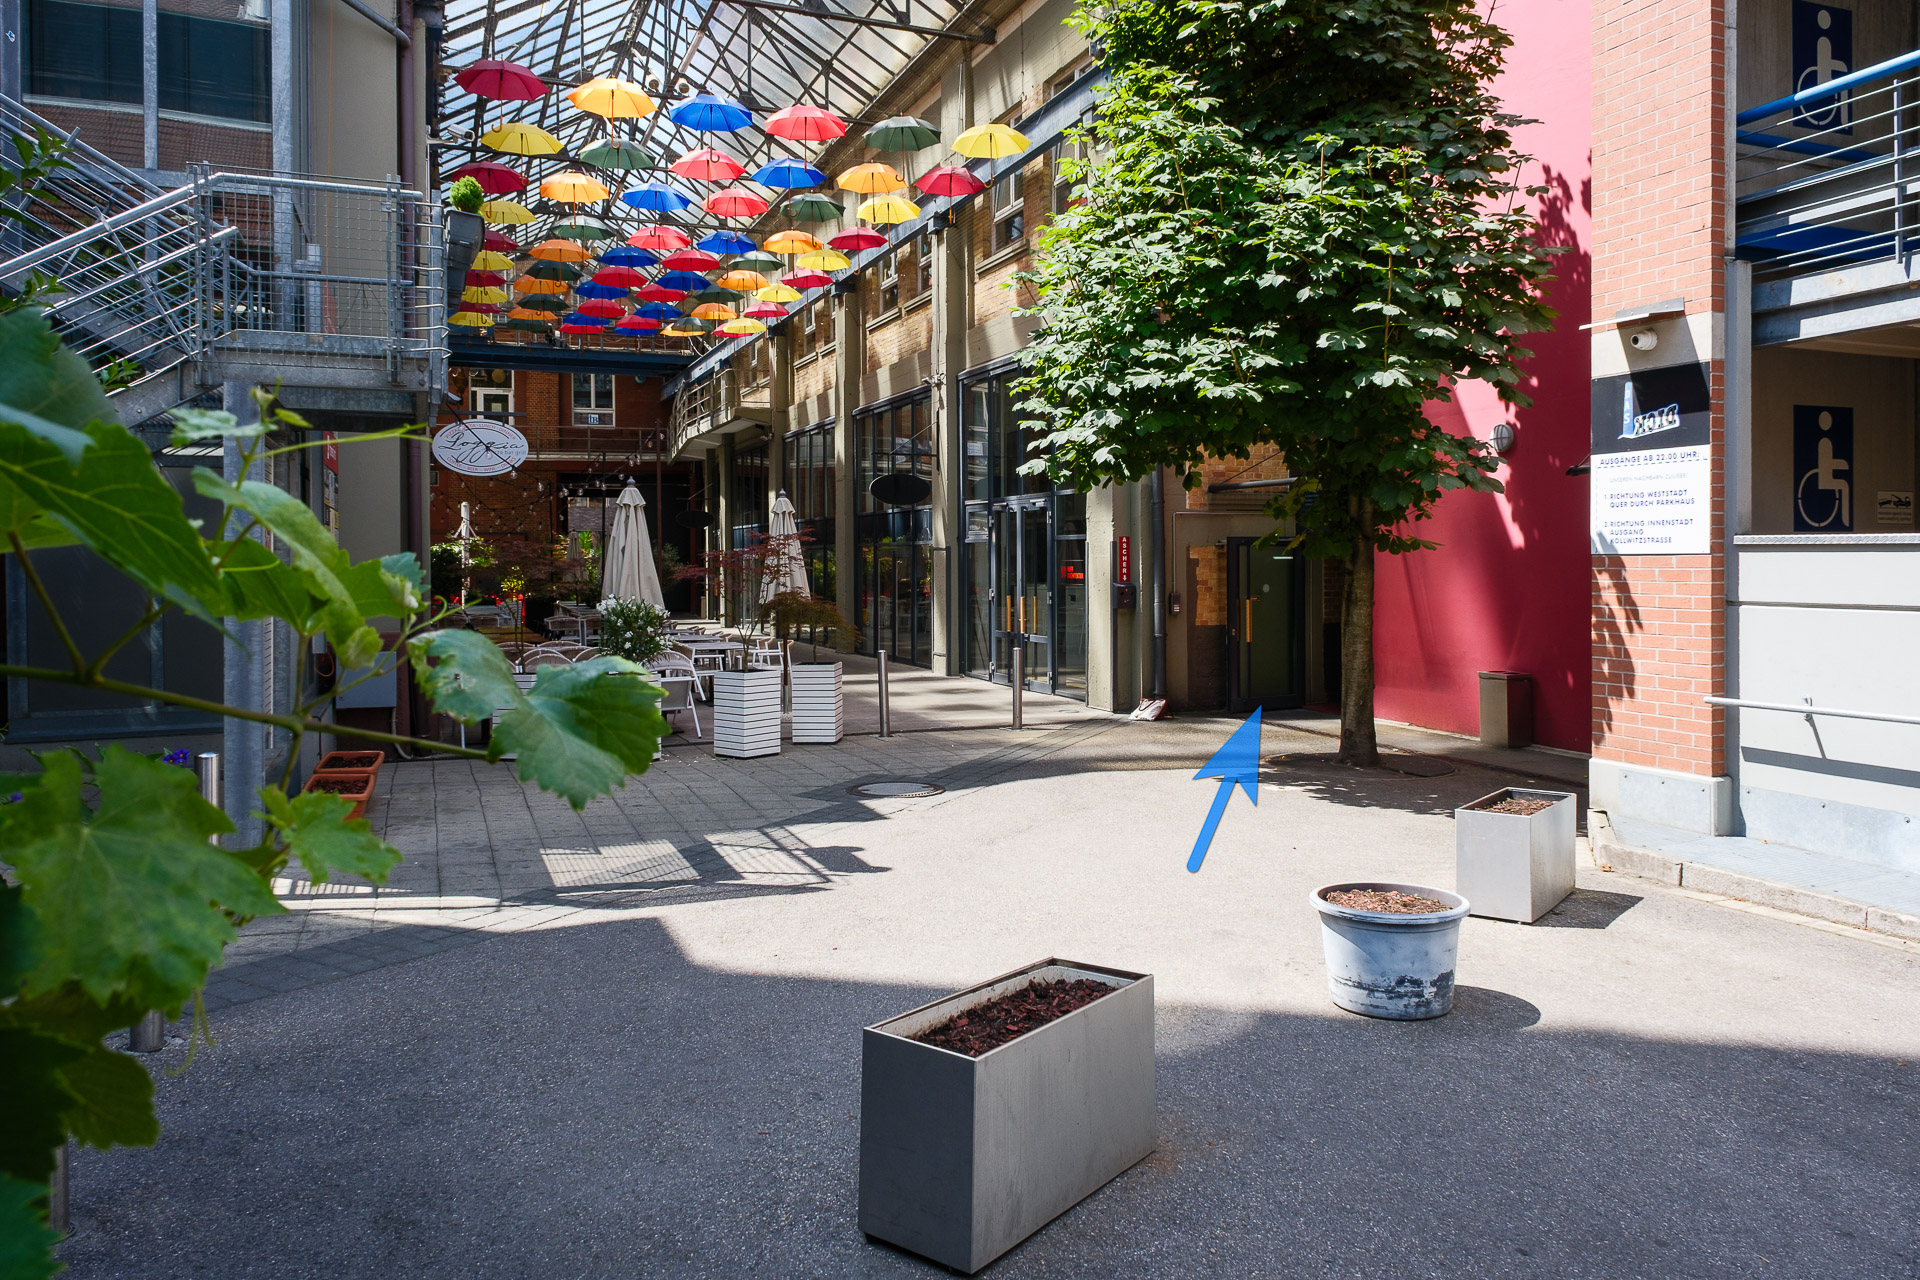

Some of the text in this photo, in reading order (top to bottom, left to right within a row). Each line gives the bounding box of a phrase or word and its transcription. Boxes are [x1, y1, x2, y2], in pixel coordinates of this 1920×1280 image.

[1623, 389, 1631, 425] DAS
[438, 431, 525, 464] Loggia
[1643, 454, 1654, 462] AB
[1656, 452, 1678, 461] 22.00
[1610, 491, 1645, 500] RICHTUNG
[1647, 489, 1687, 498] WESTSTADT
[1630, 500, 1654, 508] DURCH
[1656, 497, 1695, 506] PARKHAUS
[1610, 520, 1645, 528] RICHTUNG
[1647, 518, 1694, 526] INNENSTADT
[1610, 528, 1644, 537] AUSGANG
[1610, 536, 1672, 545] KOLLWITZSTRASSE
